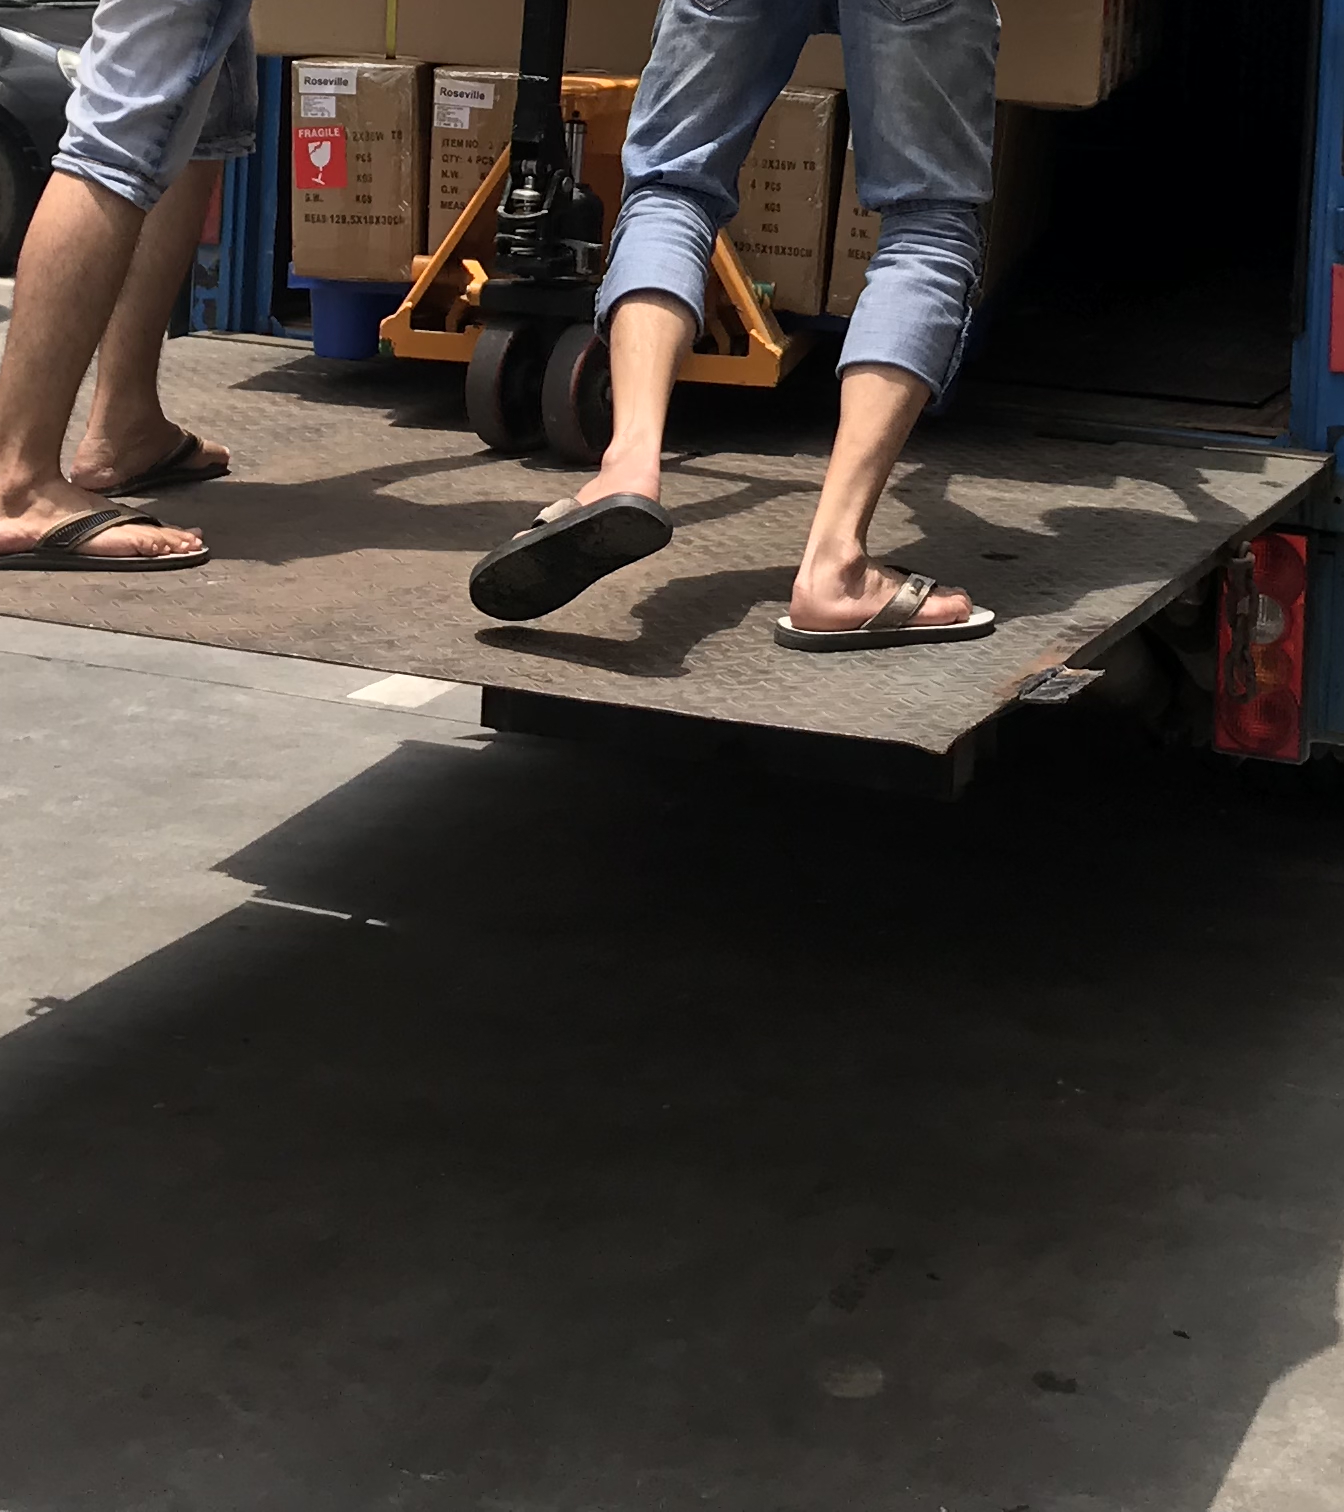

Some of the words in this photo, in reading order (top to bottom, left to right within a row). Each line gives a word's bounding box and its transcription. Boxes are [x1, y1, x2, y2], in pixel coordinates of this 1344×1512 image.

[304, 76, 349, 87] Roseville
[440, 87, 485, 100] Roseville
[298, 127, 341, 138] FRAGILE
[441, 139, 464, 148] ITEM
[356, 153, 372, 163] PCS
[476, 156, 494, 166] PCS
[764, 180, 782, 192] PCS
[356, 194, 373, 204] KGS
[764, 203, 781, 213] KGS
[761, 223, 779, 234] KGS
